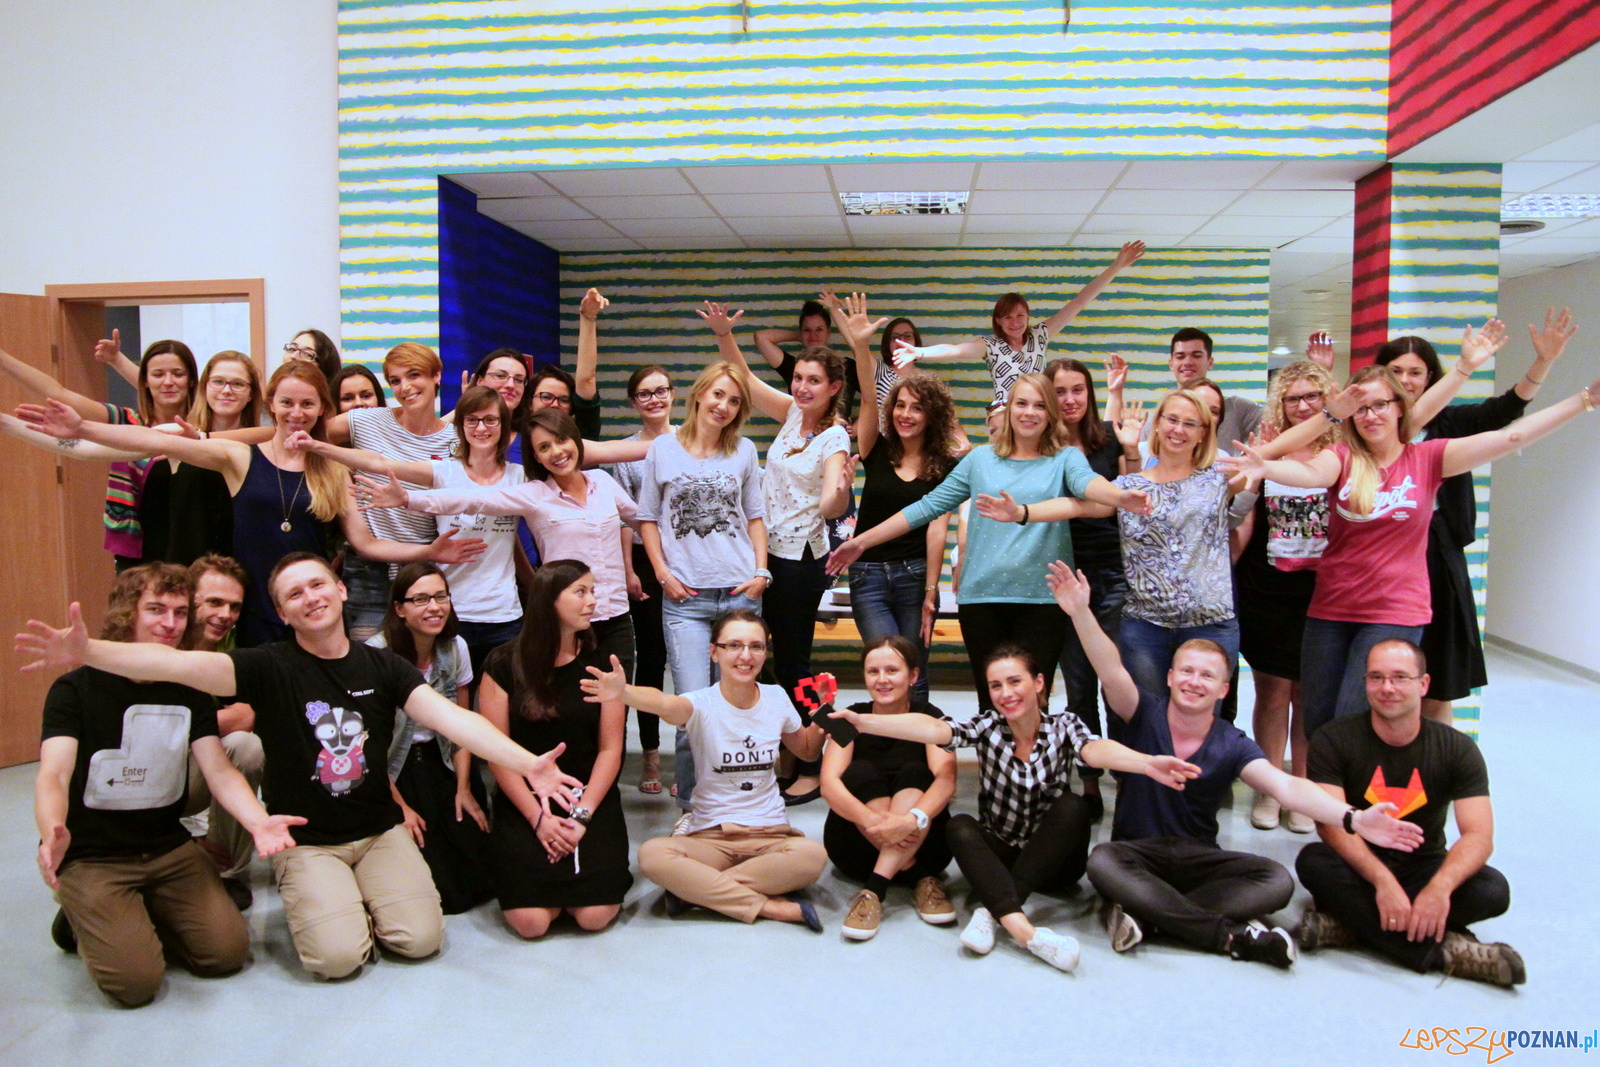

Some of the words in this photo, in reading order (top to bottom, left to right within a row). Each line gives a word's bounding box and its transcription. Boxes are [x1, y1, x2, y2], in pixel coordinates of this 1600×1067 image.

[1282, 526, 1328, 537] HILLS
[722, 749, 774, 764] DON'T
[122, 766, 147, 777] Enter
